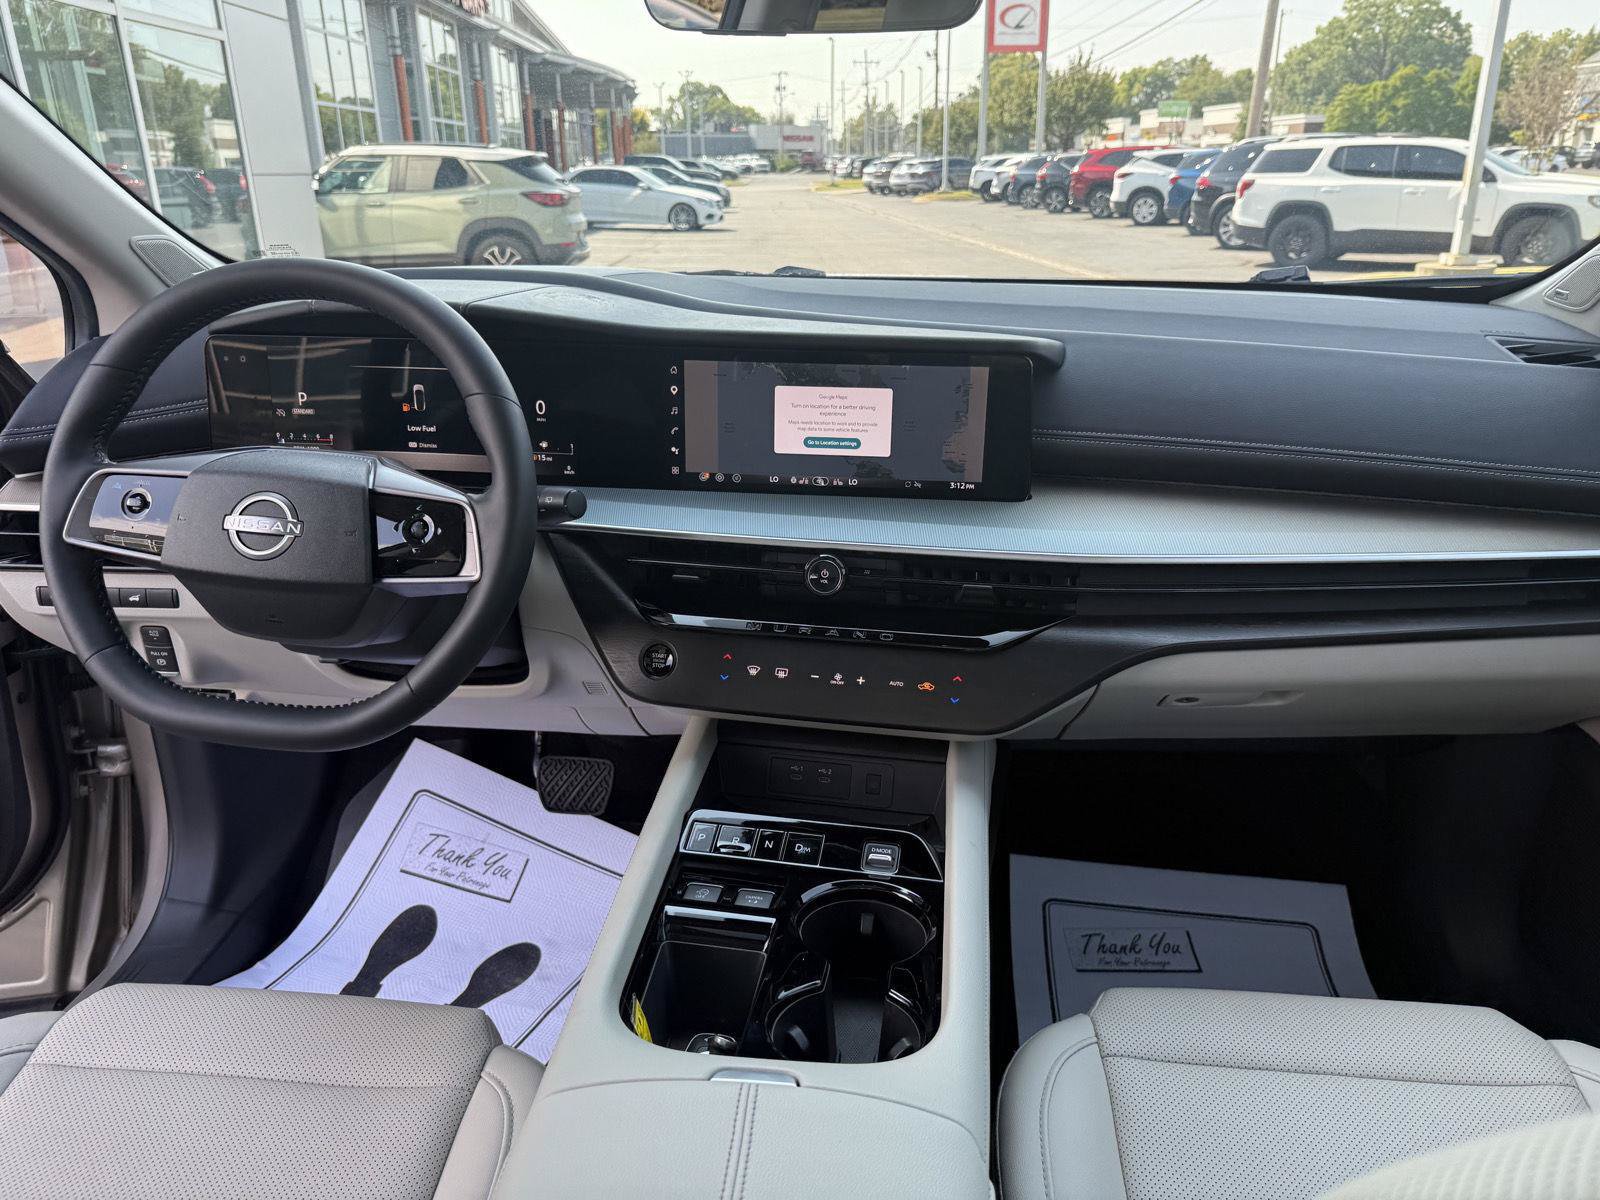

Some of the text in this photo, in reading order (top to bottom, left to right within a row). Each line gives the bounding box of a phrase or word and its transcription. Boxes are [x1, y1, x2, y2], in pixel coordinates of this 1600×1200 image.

[297, 392, 307, 406] P
[535, 400, 546, 415] 0
[858, 404, 876, 412] driving
[407, 424, 422, 432] Low
[848, 478, 858, 486] LO
[223, 516, 302, 534] NISSAN
[731, 836, 740, 845] R
[764, 840, 774, 848] N
[418, 833, 512, 880] Thank You
[424, 862, 438, 873] For
[440, 866, 455, 878] Your
[1080, 932, 1182, 956] Thank You
[1099, 956, 1112, 965] For
[1114, 957, 1130, 966] Your
